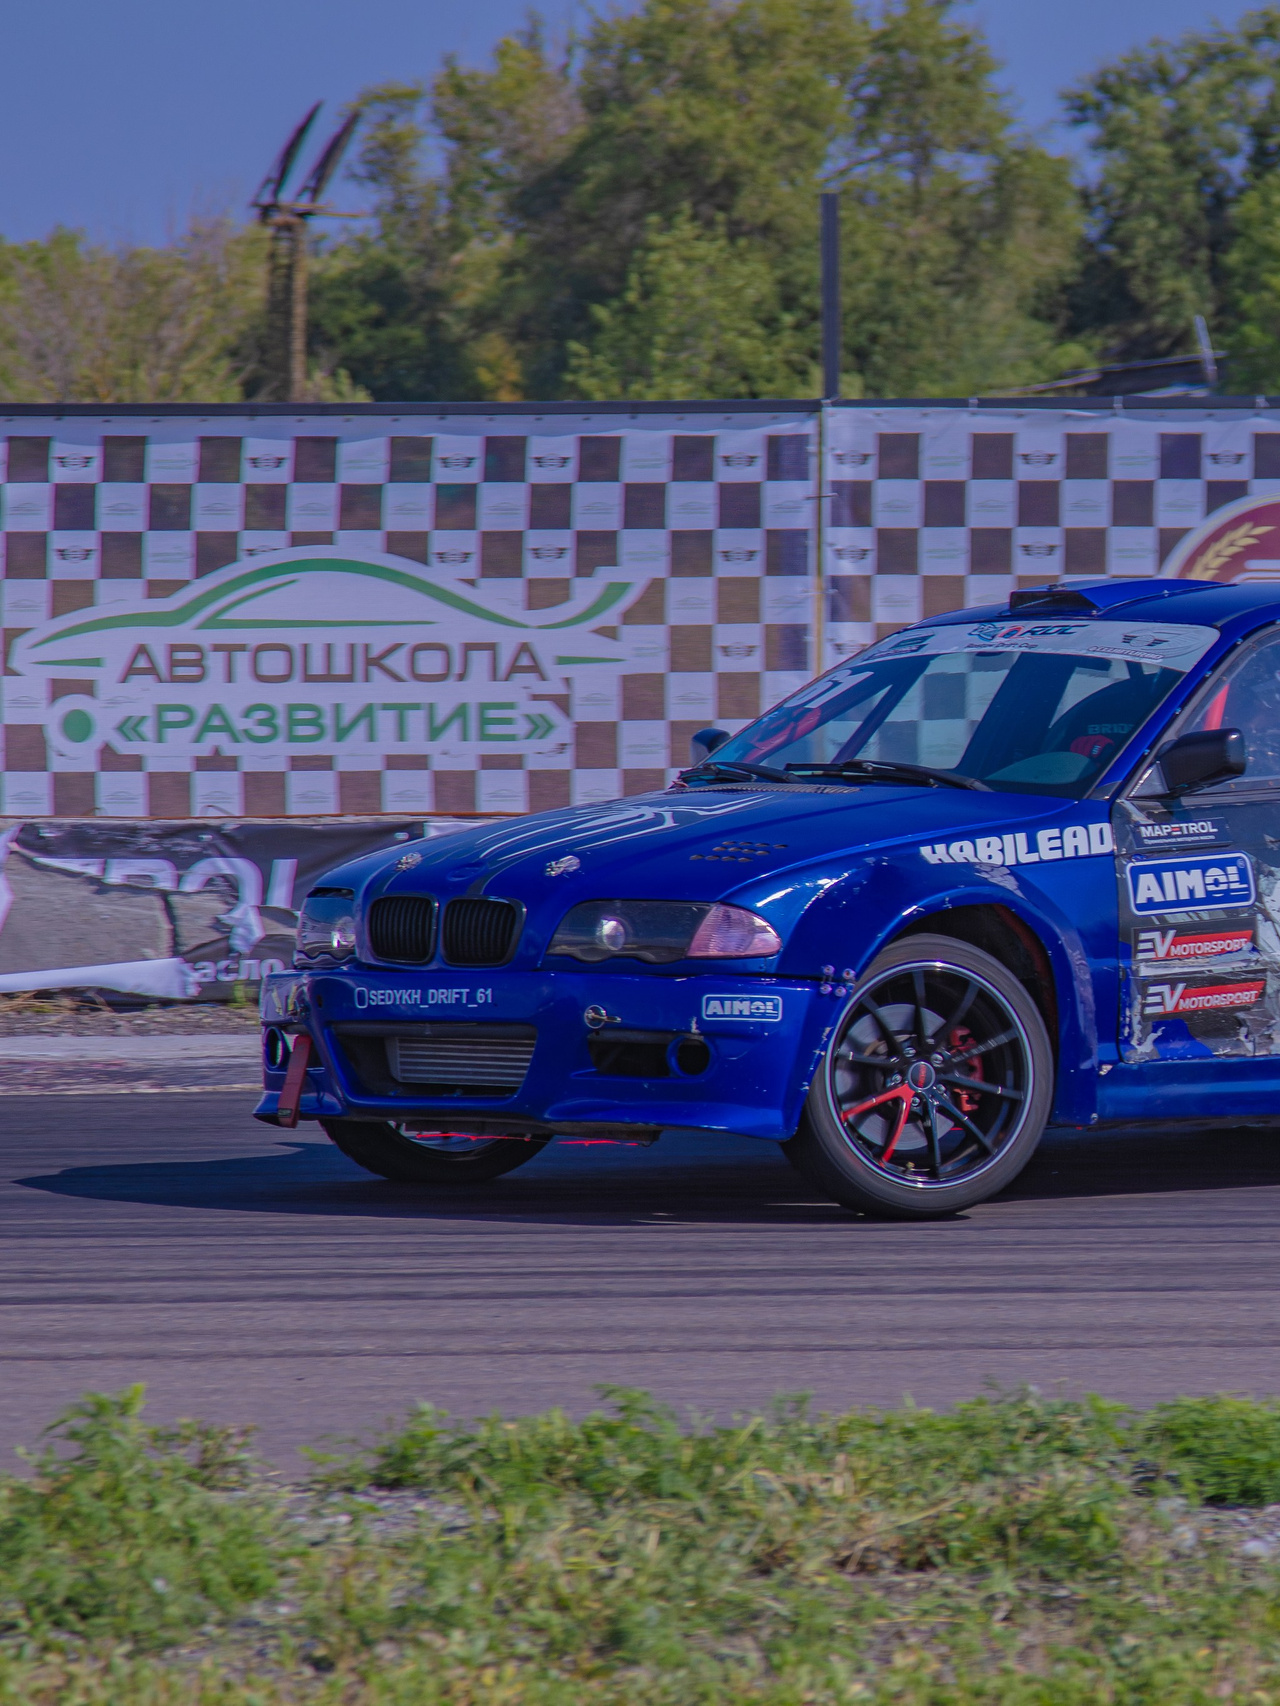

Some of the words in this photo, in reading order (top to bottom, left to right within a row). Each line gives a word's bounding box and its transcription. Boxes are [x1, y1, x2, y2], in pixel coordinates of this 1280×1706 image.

[117, 641, 548, 683] АВТОШКОЛА
[115, 701, 558, 744] «РАЗВИТИЕ»
[1140, 821, 1219, 838] MAPETROL
[918, 822, 1116, 867] HABILEAD
[1136, 866, 1250, 904] AIMOL
[1170, 937, 1250, 957] MOTORSPORT
[190, 957, 286, 983] асло
[369, 988, 493, 1008] SEDYKH_DRIFT_61
[706, 1000, 779, 1017] AIMOL
[1178, 990, 1260, 1011] MOTORSPORT
